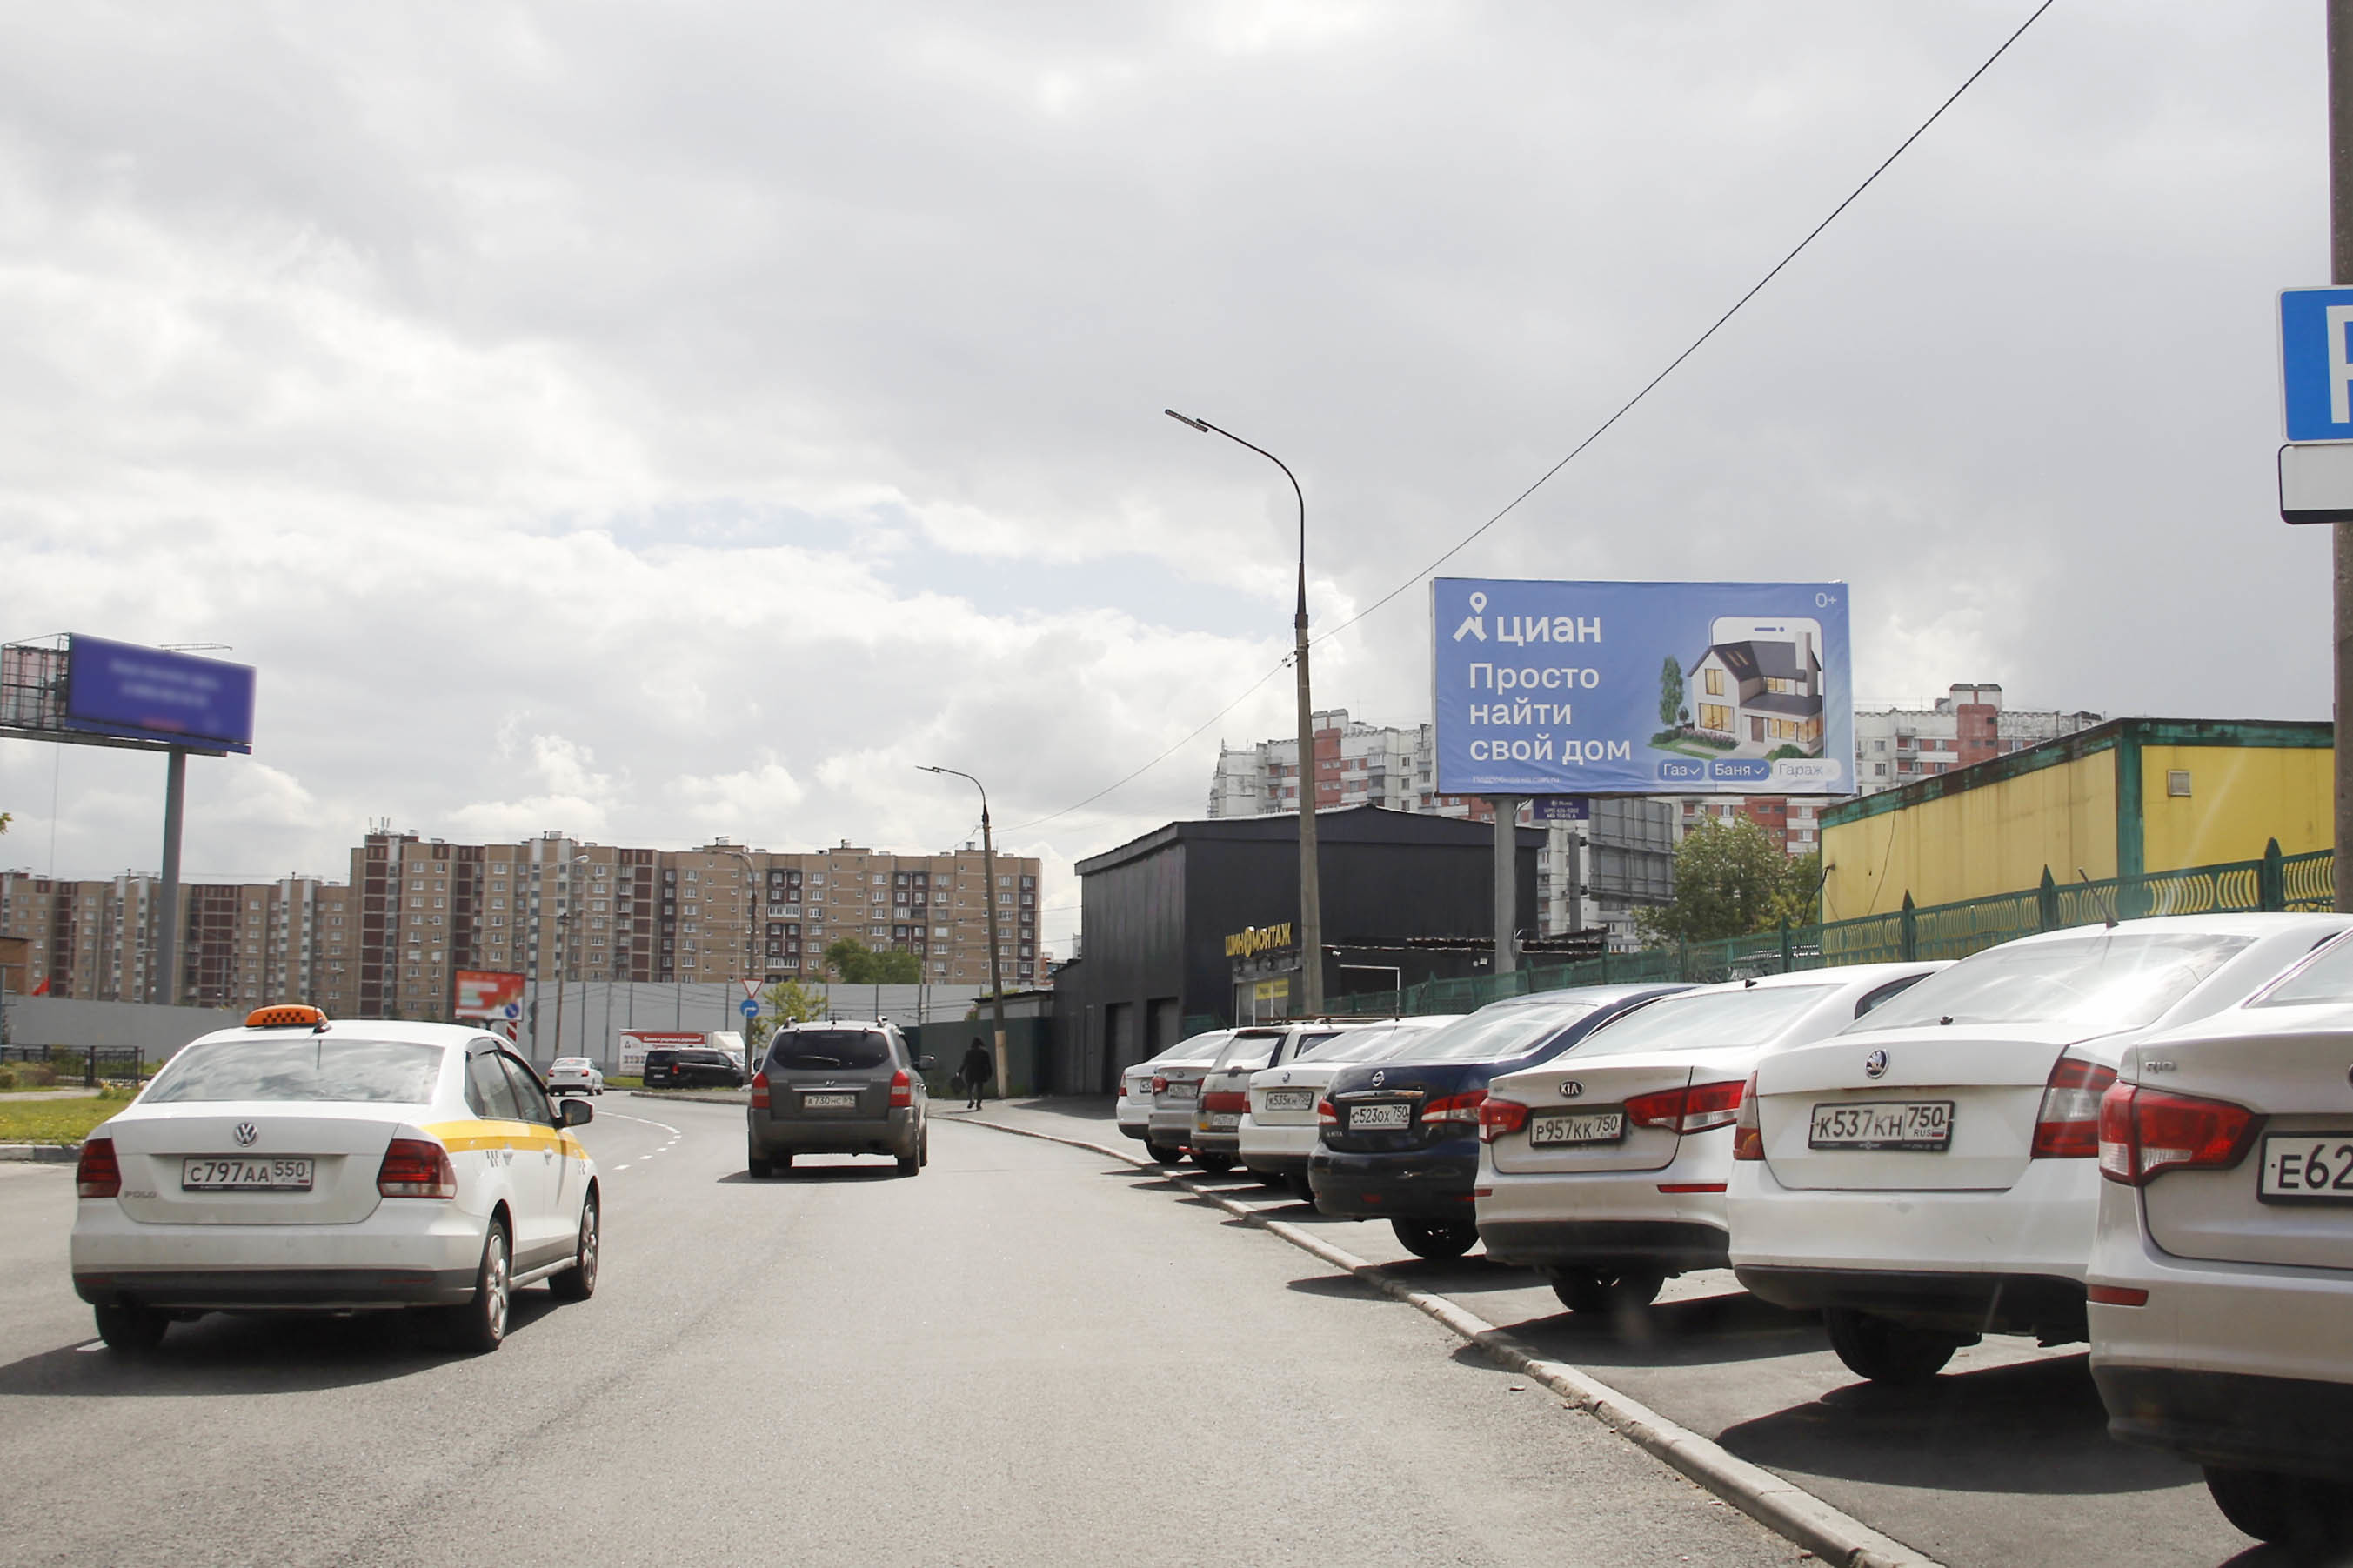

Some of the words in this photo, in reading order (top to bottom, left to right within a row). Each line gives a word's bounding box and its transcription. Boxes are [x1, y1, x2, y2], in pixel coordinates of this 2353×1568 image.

[1815, 592, 1837, 608] 0+
[1496, 616, 1601, 647] циан
[1469, 663, 1600, 695] Просто
[1469, 697, 1572, 725] найти
[1469, 733, 1553, 762] свой
[1562, 740, 1631, 765] дом
[1662, 764, 1688, 777] Газ
[1715, 763, 1751, 777] Баня
[1779, 764, 1823, 777] Гараж
[1225, 922, 1292, 957] ШИНОМОНТАЖ
[1560, 1084, 1580, 1095] KIA
[1392, 1105, 1407, 1118] 750
[1818, 1110, 1903, 1138] К537КН
[1908, 1106, 1944, 1128] 750
[1535, 1118, 1594, 1141] Р957КК
[1595, 1115, 1618, 1132] 750
[1913, 1128, 1932, 1138] RUS
[190, 1162, 270, 1183] С797АА
[273, 1161, 306, 1177] 550
